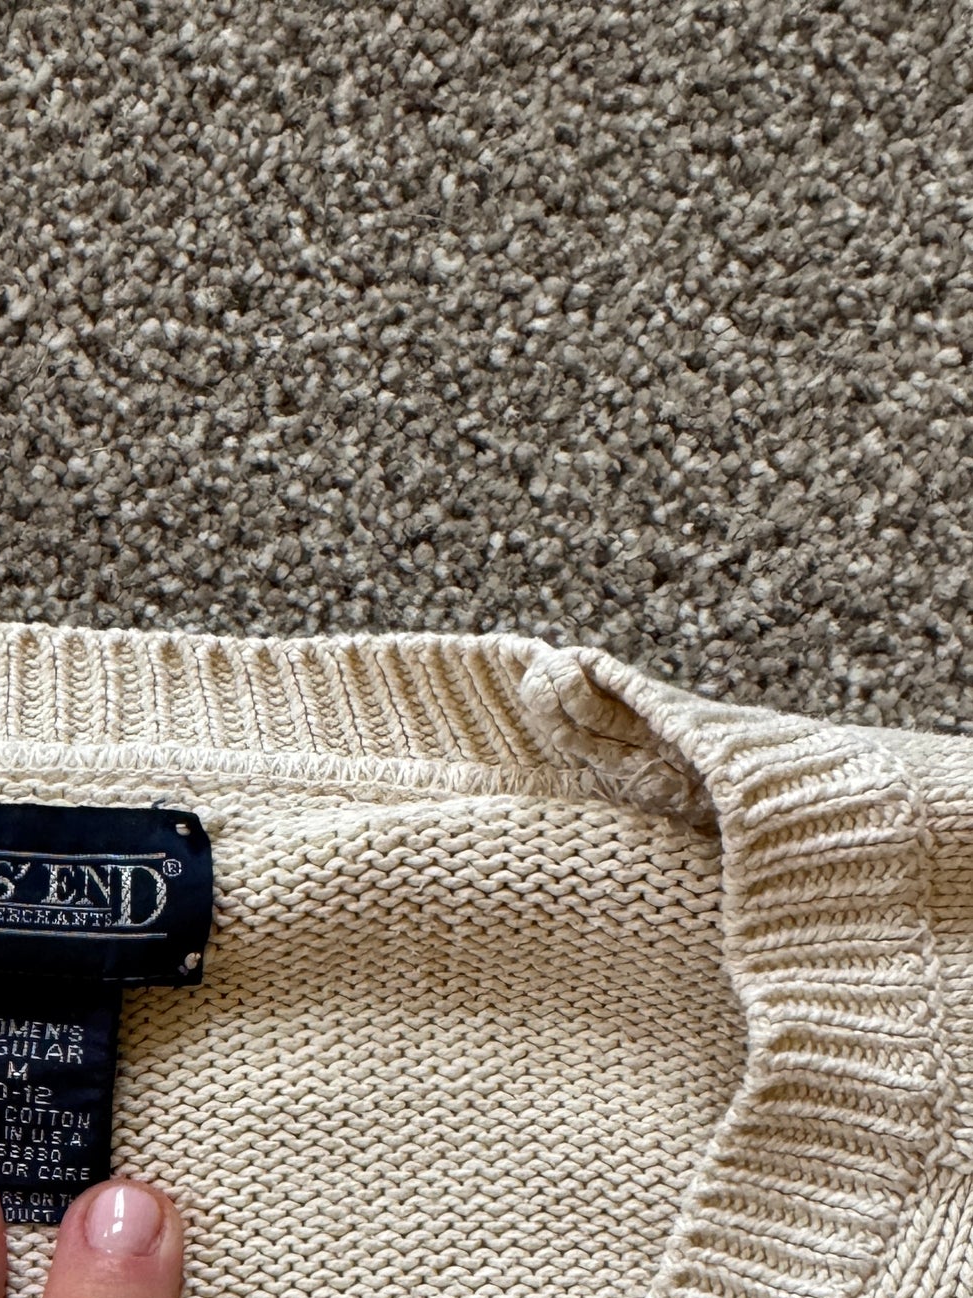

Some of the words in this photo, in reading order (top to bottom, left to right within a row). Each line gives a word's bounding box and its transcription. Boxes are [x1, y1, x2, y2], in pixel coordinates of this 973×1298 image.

[6, 1060, 28, 1081] M
[5, 1105, 91, 1128] COTTON
[4, 1125, 23, 1141] IN
[32, 1128, 88, 1147] U.S.A.
[38, 1166, 90, 1181] CARE
[30, 1192, 54, 1207] ON
[5, 1207, 57, 1223] DUCT.
